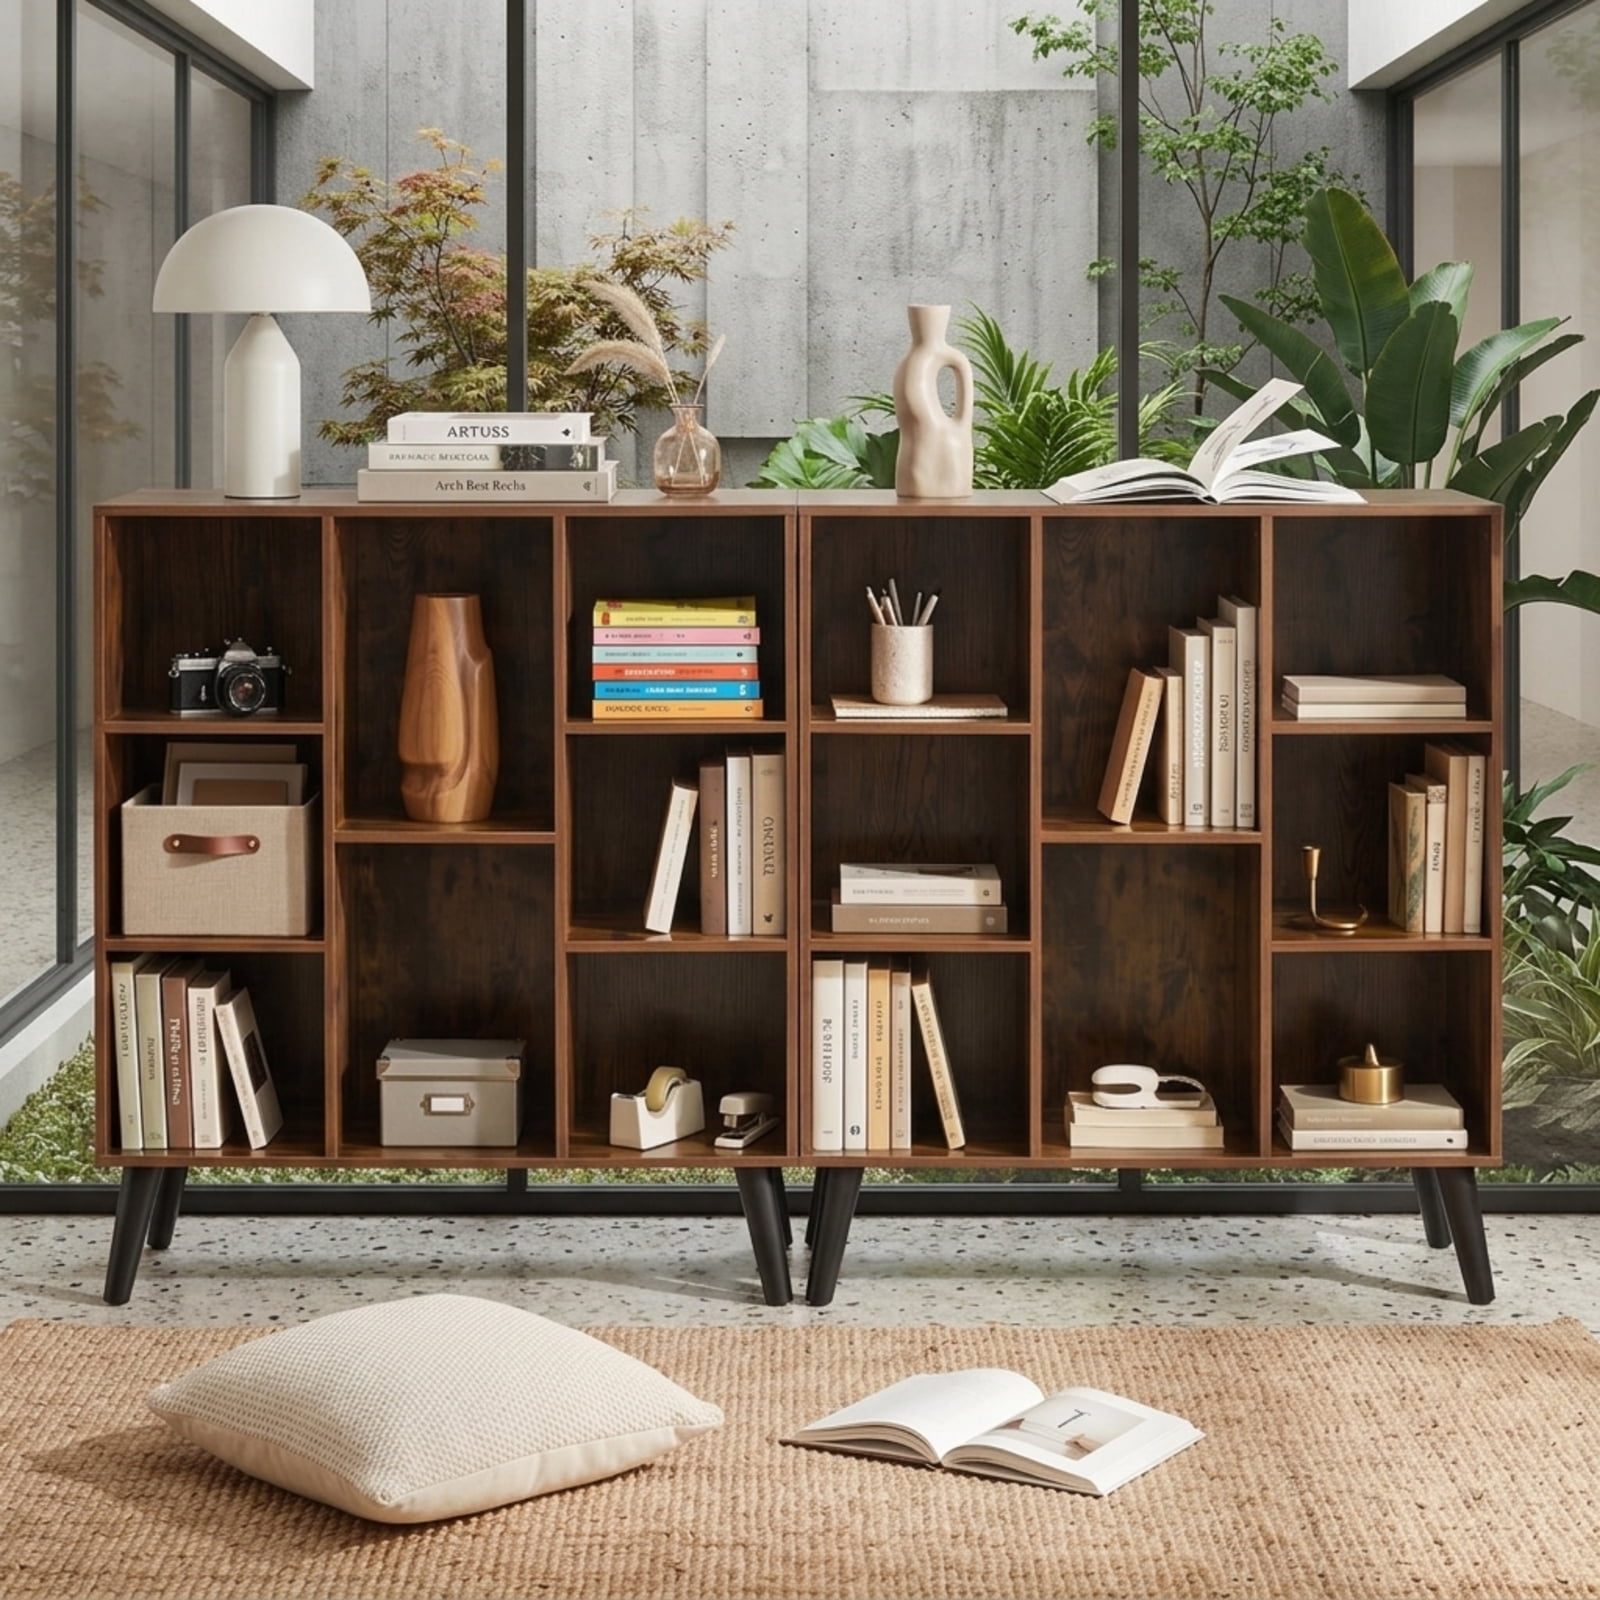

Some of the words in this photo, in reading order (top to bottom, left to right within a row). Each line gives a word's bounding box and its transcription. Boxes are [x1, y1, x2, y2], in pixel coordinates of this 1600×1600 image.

[447, 425, 510, 438] ARTUSS
[435, 479, 463, 491] Arch
[466, 479, 489, 491] Best
